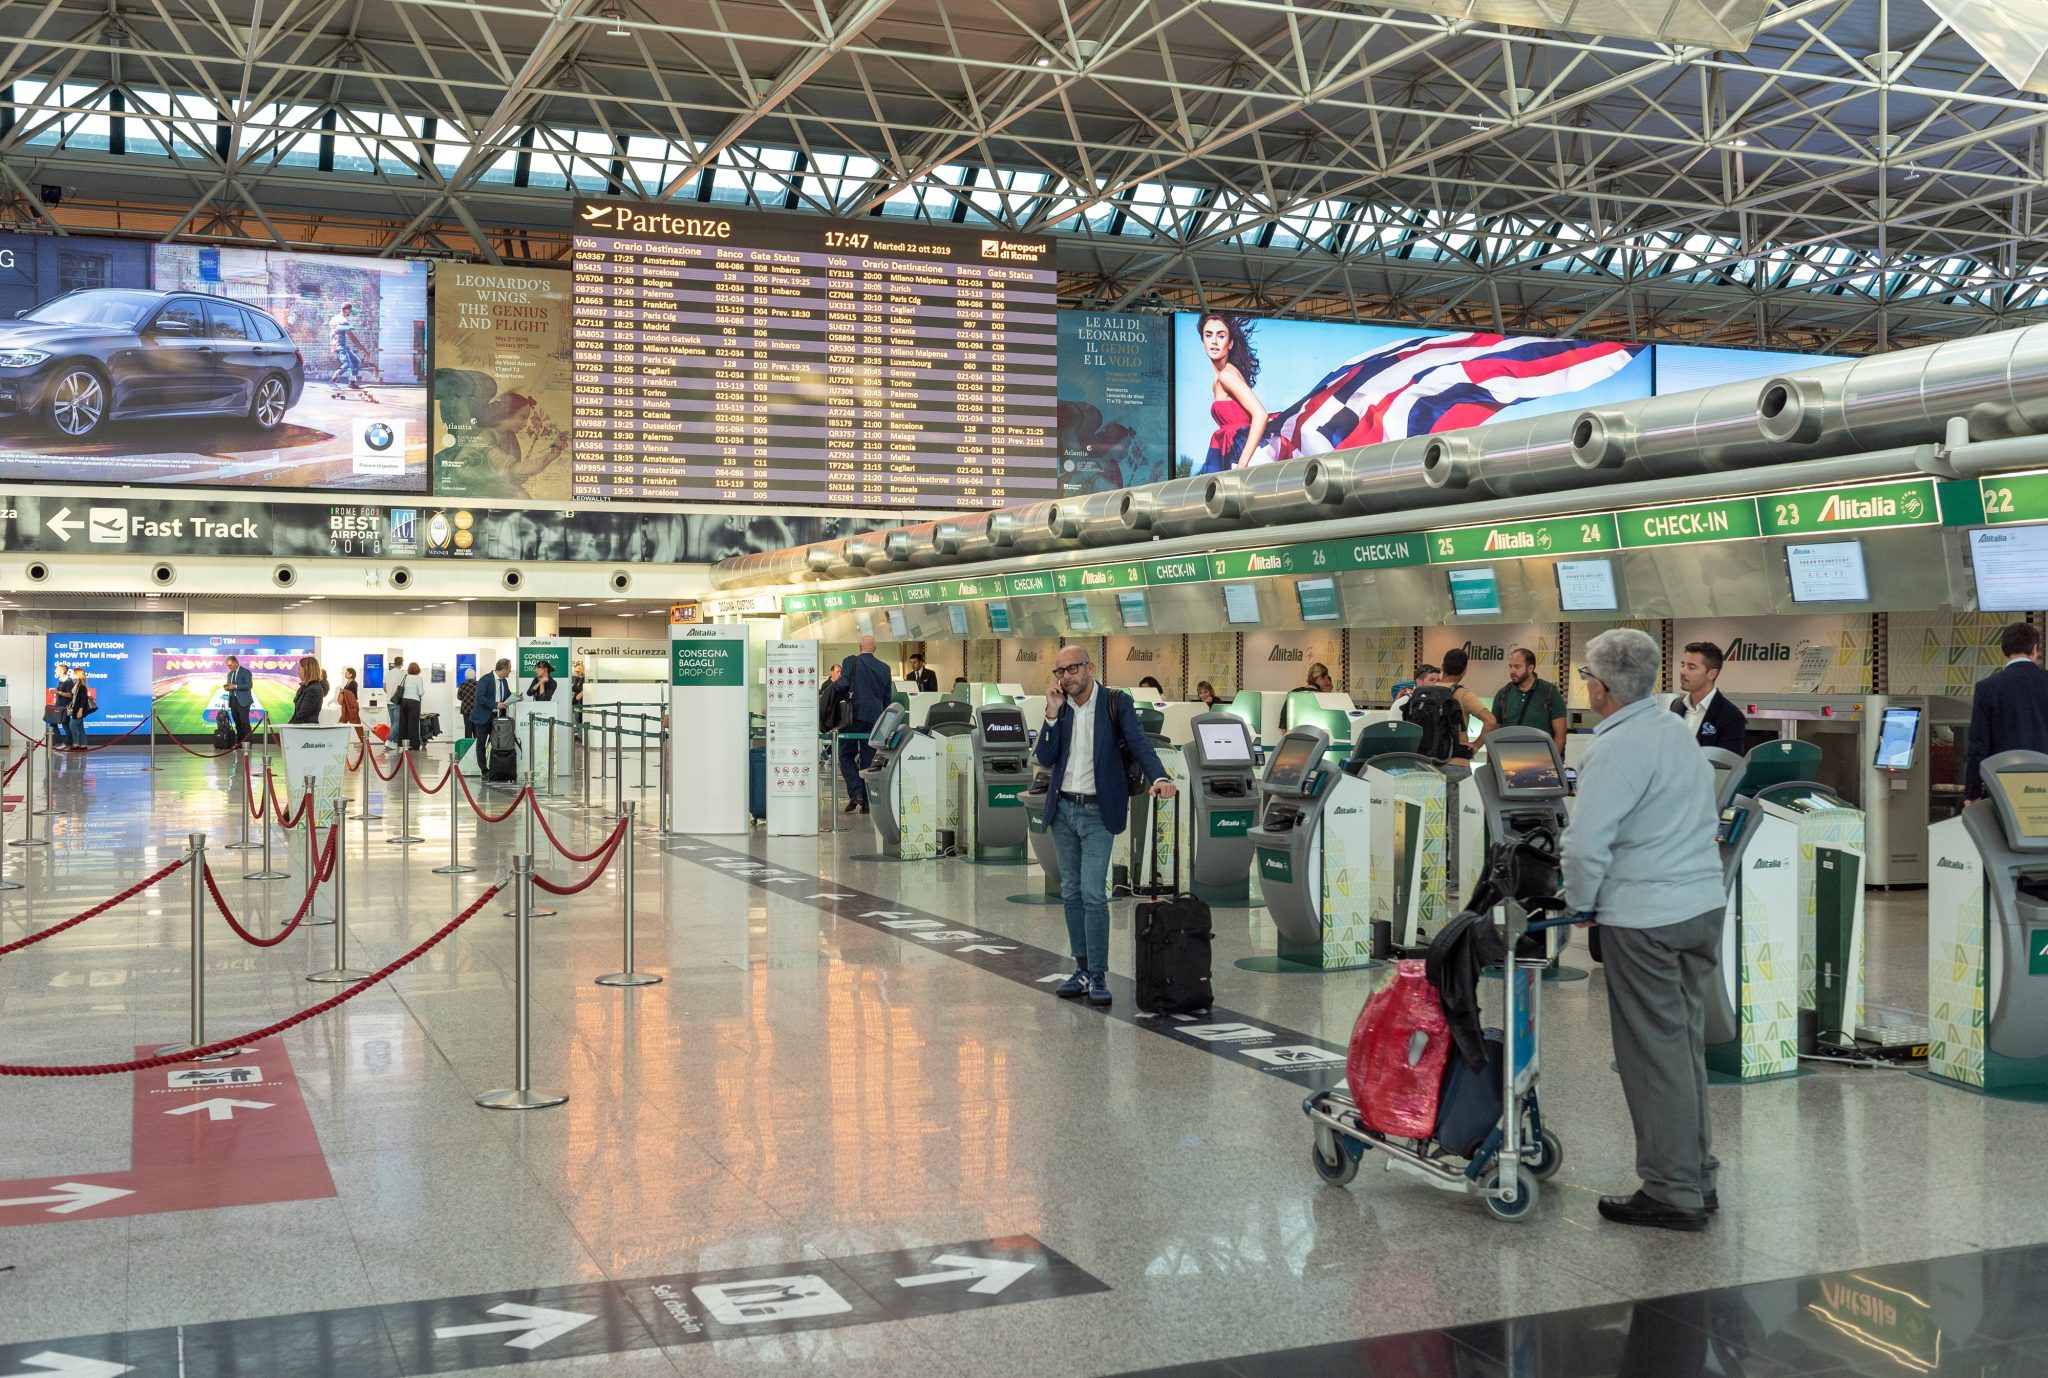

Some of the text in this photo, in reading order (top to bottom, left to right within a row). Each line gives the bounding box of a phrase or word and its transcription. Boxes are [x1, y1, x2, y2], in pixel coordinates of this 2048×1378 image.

[616, 207, 731, 238] Partenze
[825, 232, 951, 255] 17:47 Martedì 22 ott 2019
[1000, 241, 1046, 253] Aeroporti
[576, 239, 800, 263] Volo Orario Destinazione Banco Gate Status
[1011, 252, 1037, 261] Roma
[576, 252, 605, 261] GA9367
[613, 254, 634, 263] 17:25
[643, 257, 686, 267] Amsterdam
[716, 262, 745, 271] 084-086
[772, 265, 800, 275] Imbarco
[828, 257, 1033, 280] Volo Orario Destinazione Banco Gate Status
[576, 263, 811, 286] IB5425 17:35 Barcelona 128 D06 Prev. 19:25
[828, 270, 1005, 289] EY3135 20:00 Milano Malpensa 021-034 B04
[456, 274, 551, 291] LEONARDO'S
[576, 274, 800, 296] SV6704 17:40 Bologna 021-034 B15 Imbarco
[476, 290, 531, 303] WINGS.
[828, 281, 1005, 300] LX1733 20:05 Zurich 115-119 D04
[458, 303, 548, 318] THE GENIUS
[458, 318, 549, 332] AND FLIGHT
[1086, 317, 1140, 330] LE ALI DI
[1078, 329, 1148, 343] LEONARDO.
[1087, 342, 1139, 354] IL GENIO
[1084, 355, 1142, 367] E IL VOLO
[1064, 449, 1088, 457] Atlantia
[1984, 488, 2014, 513] 22
[1775, 495, 1896, 526] 23 Alitalia
[132, 516, 258, 539] Fast Track
[331, 516, 380, 530] BEST
[393, 511, 415, 538] ACI
[1643, 511, 1728, 538] CHECK-IN
[331, 531, 380, 539] AIRPORT
[1438, 524, 1600, 555] 25 Alitalia 24
[1978, 534, 2007, 543] Alitalia
[1353, 542, 1410, 562] CHECK-IN
[1215, 550, 1326, 574] 27 Alitalia 26
[1156, 562, 1196, 579] CHECK-IN
[1014, 577, 1043, 590] CHECK-IN
[1058, 568, 1138, 588] 29 Alitalia 28
[908, 588, 930, 600] CHECK-IN
[941, 581, 1001, 597] 31 Alitalia 30
[824, 596, 843, 607] CHECK-IN
[865, 592, 880, 603] Alitalia
[686, 628, 717, 637] Alitalia
[577, 646, 666, 656] Controlli sicurezza
[679, 649, 728, 658] CONSEGNA
[1016, 648, 1038, 662] Alitalia
[1126, 646, 1153, 662] Alitalia
[1268, 645, 1303, 662] Alitalia
[1724, 637, 1790, 661] Alitalia
[166, 661, 214, 671] NOW
[249, 660, 296, 670] NOW
[679, 659, 715, 667] BAGAGLI
[679, 668, 724, 677] DROP-OFF
[987, 723, 1012, 731] Alitalia
[1333, 806, 1357, 815] Alitalia
[1753, 858, 1782, 870] Alitalia
[1936, 857, 1964, 870] Alitalia
[150, 1082, 283, 1094] Priority check-in
[650, 1285, 703, 1333] Self check-in
